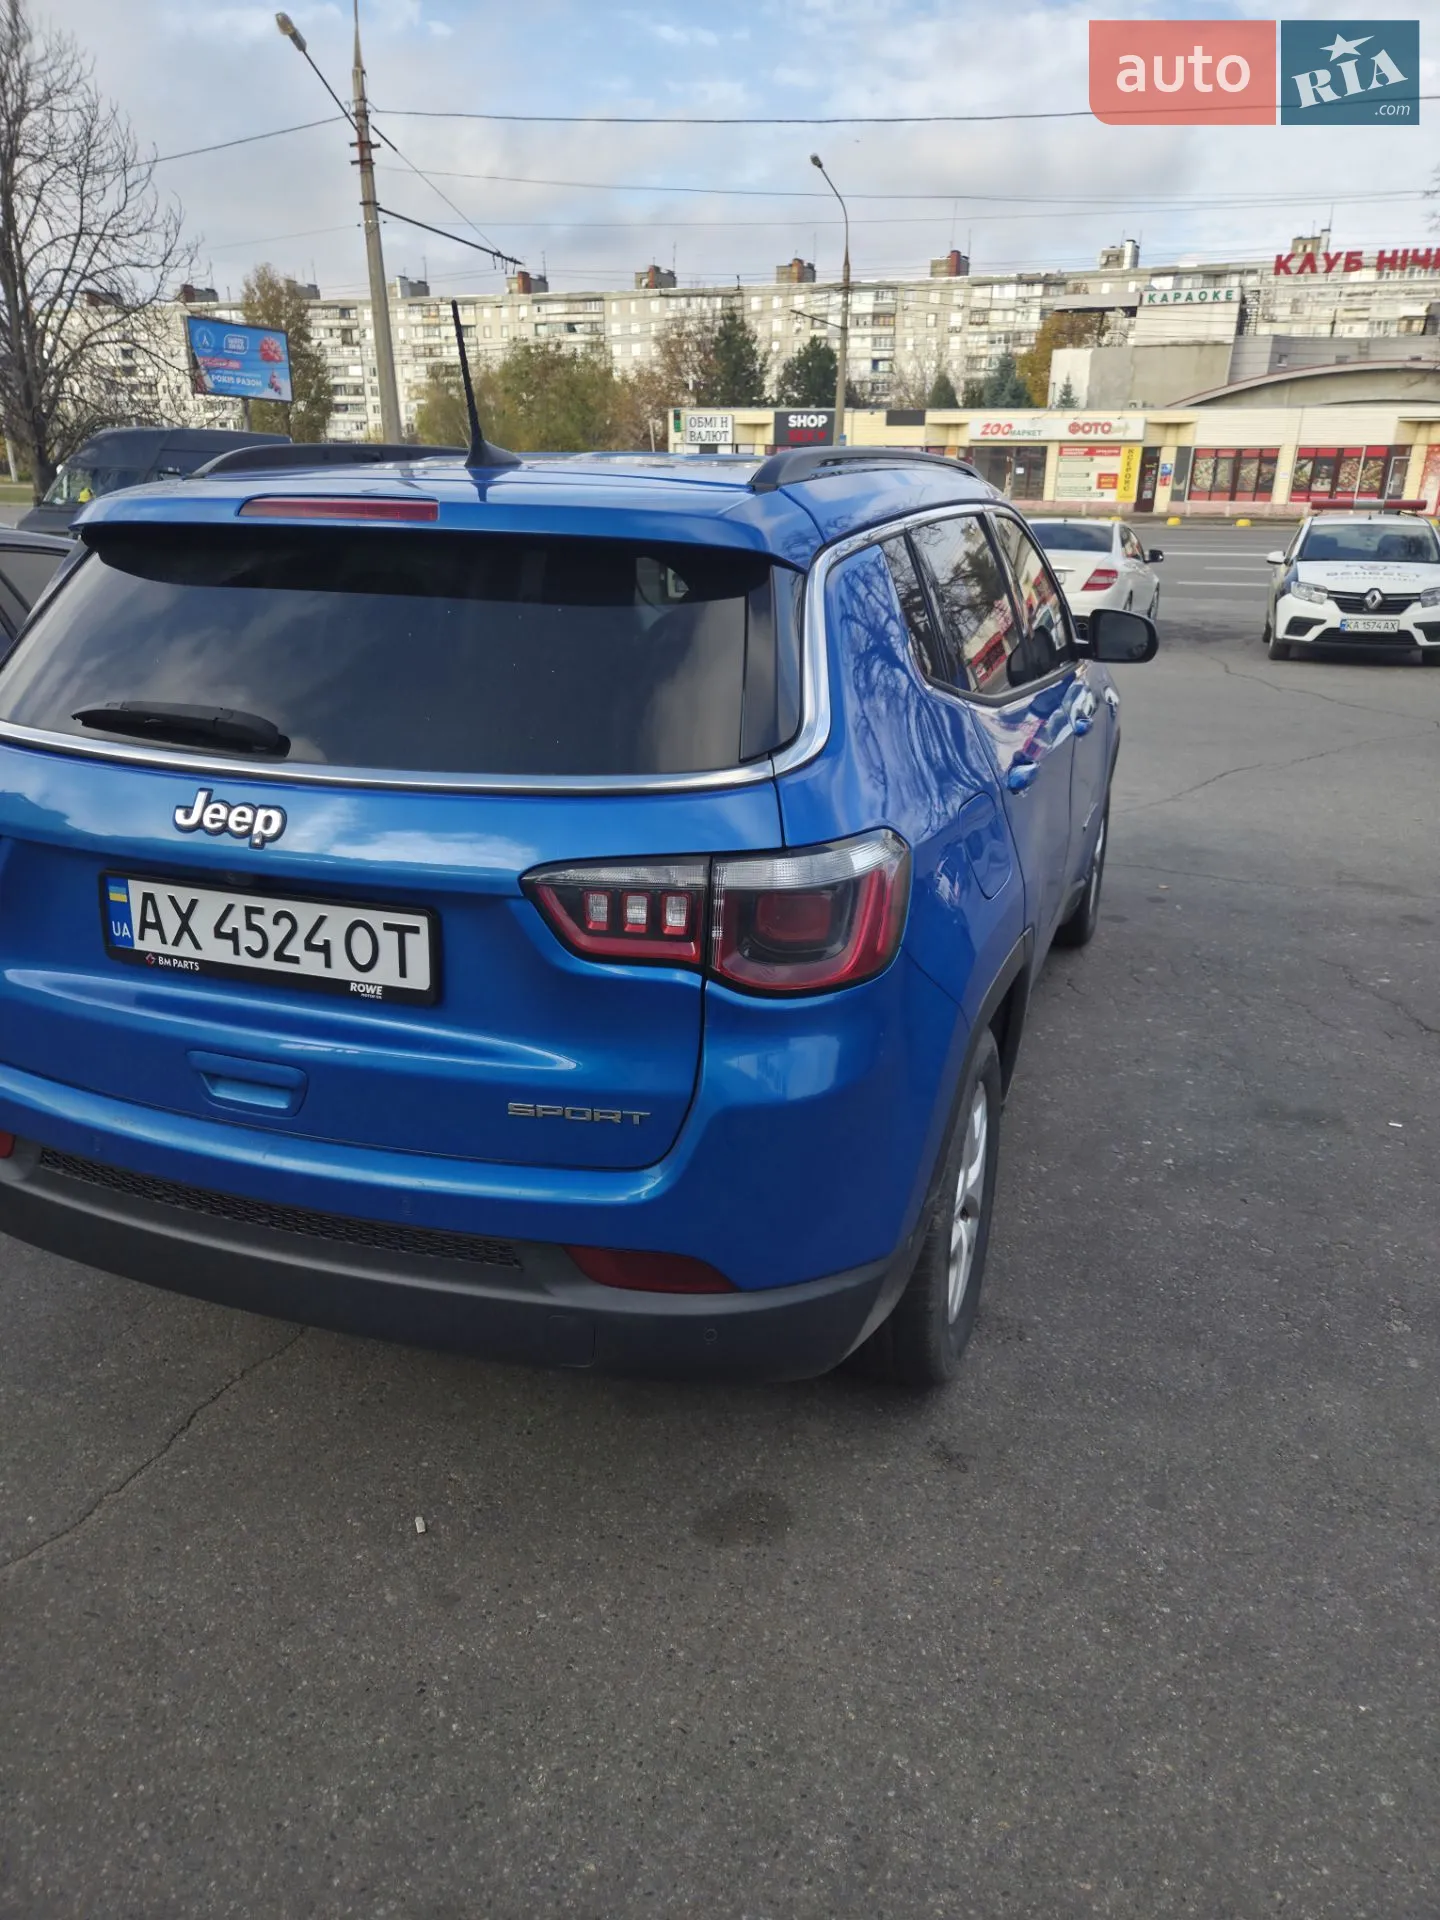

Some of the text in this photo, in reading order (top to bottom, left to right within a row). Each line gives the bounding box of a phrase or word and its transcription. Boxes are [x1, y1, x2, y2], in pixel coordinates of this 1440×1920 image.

[1273, 251, 1364, 276] КЛУБ
[1148, 289, 1234, 303] КАРАОКЕ
[788, 414, 828, 428] SHOP
[1068, 422, 1112, 435] ФОТО
[689, 430, 729, 442] ВАЛЮТ
[174, 788, 286, 848] Jeep
[138, 891, 203, 951] AX
[112, 920, 132, 939] UA
[158, 956, 200, 972] BM PARTS
[350, 982, 383, 995] ROWE
[508, 1102, 650, 1125] SPORT
